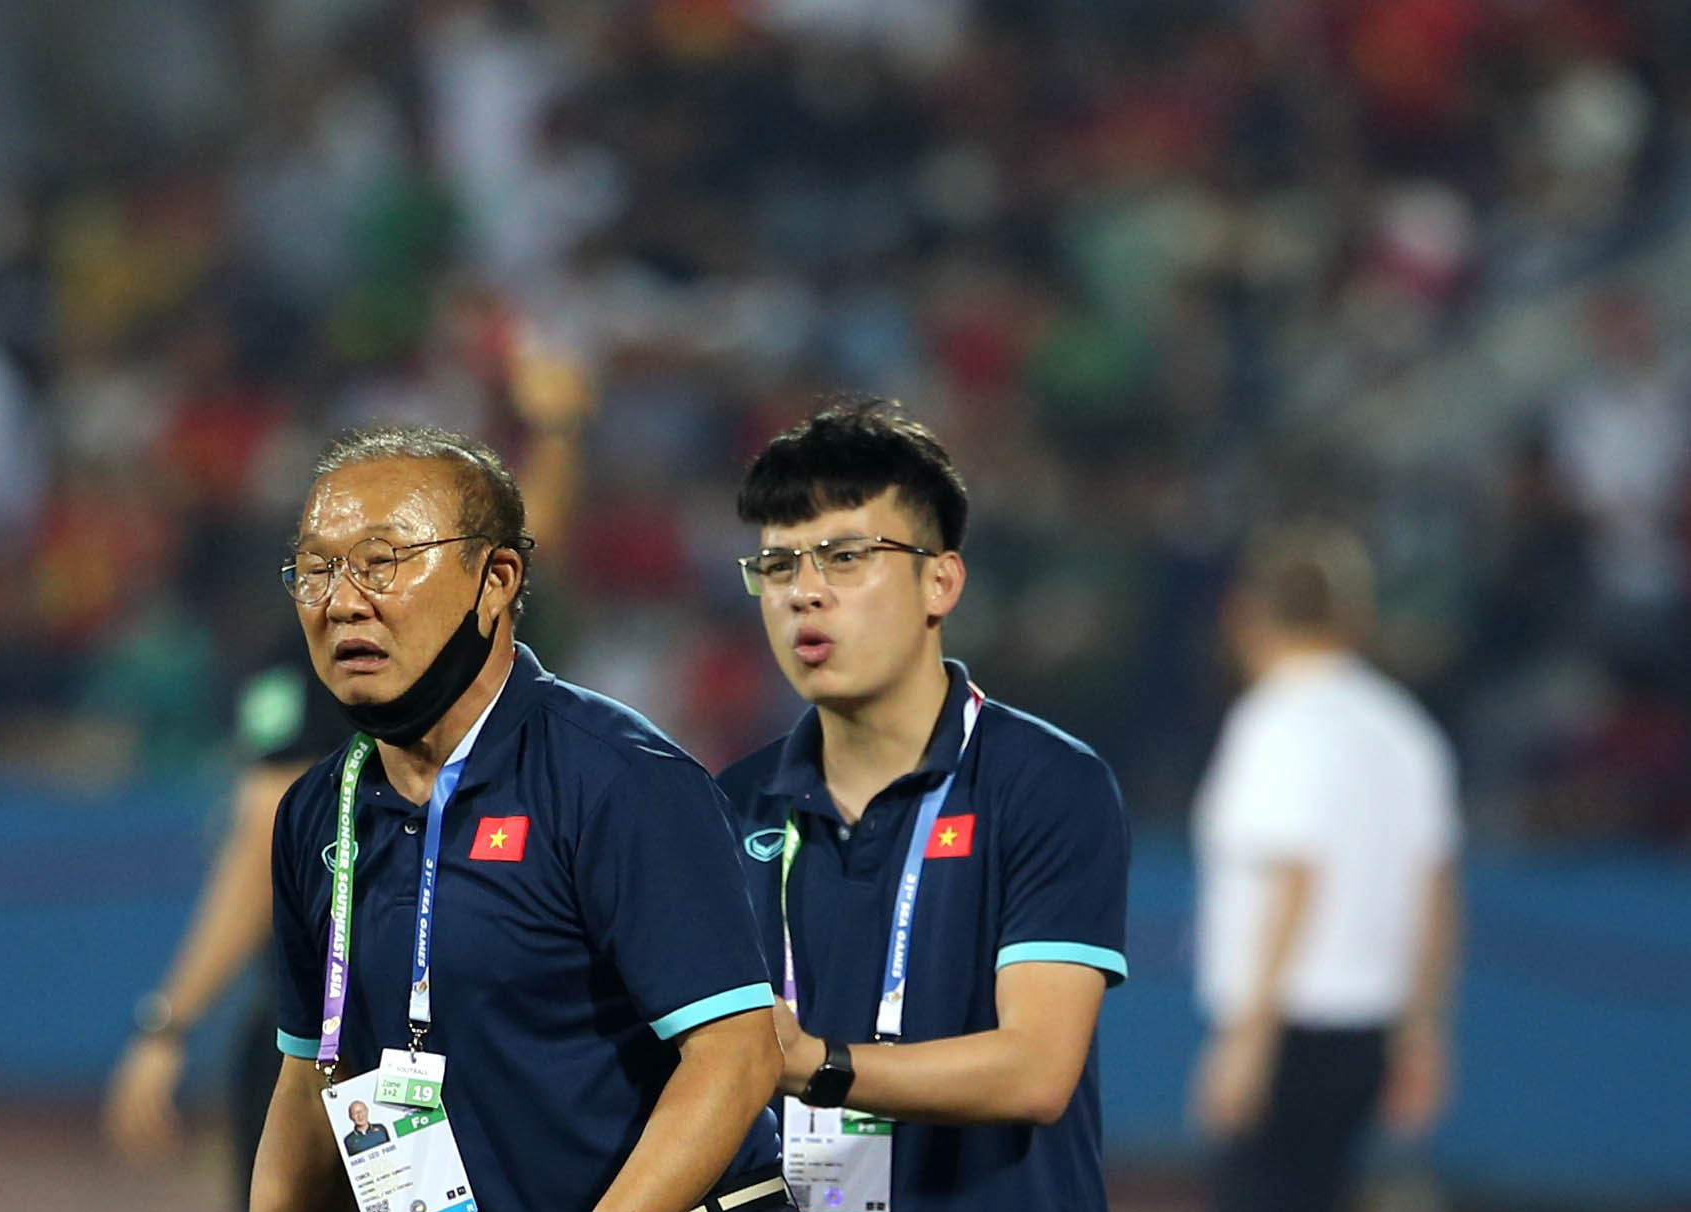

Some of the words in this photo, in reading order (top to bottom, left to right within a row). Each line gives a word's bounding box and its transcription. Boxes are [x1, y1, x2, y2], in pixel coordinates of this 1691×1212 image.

[350, 742, 369, 769] FOR
[345, 773, 355, 783] A
[338, 786, 352, 869] STRONGER
[332, 871, 349, 962] SOUTHEAST
[420, 887, 431, 915] SEA
[897, 901, 911, 928] SEA
[417, 917, 428, 968] GAMES
[891, 929, 907, 979] GAMES
[329, 961, 344, 999] ASIA
[412, 1084, 434, 1102] 19
